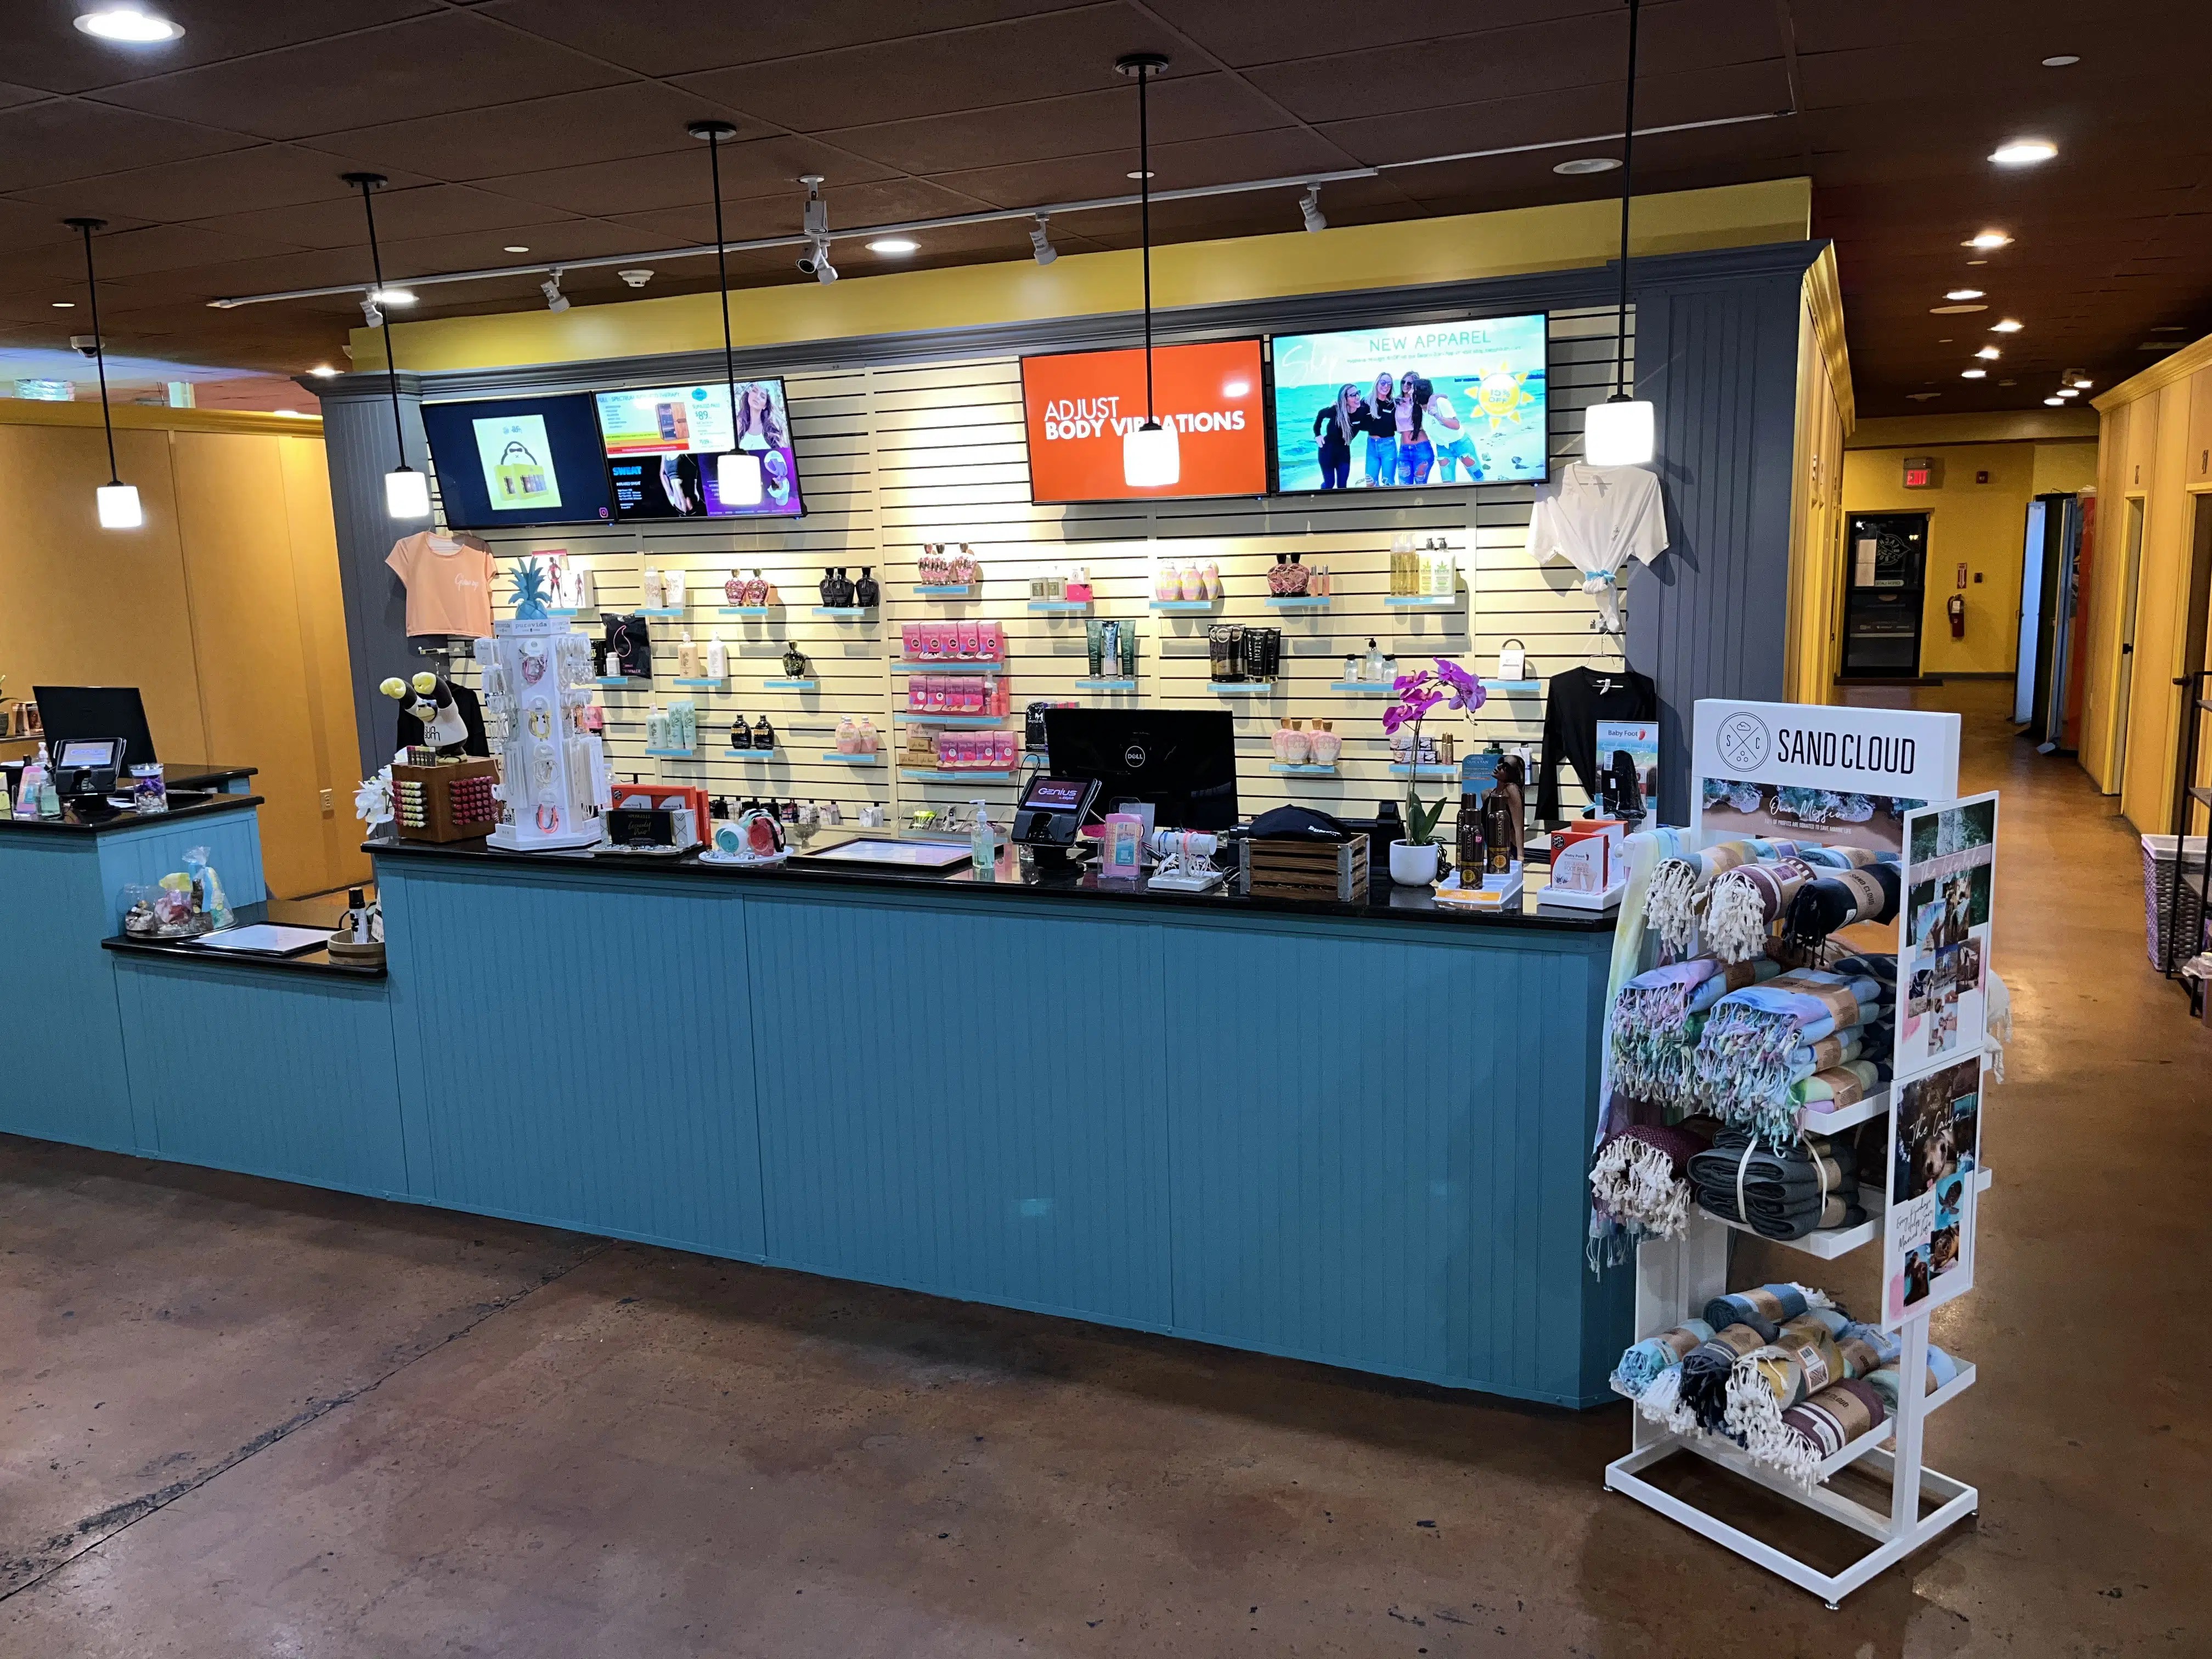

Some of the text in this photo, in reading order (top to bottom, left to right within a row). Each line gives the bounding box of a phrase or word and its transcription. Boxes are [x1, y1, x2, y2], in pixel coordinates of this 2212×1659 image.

[1369, 330, 1491, 352] NEW APPAREL
[1490, 388, 1510, 398] 15%
[1044, 396, 1120, 421] ADJUST
[1046, 419, 1105, 441] BODY
[612, 466, 642, 476] SWEAT
[1907, 470, 1927, 486] EXIT
[1726, 735, 1731, 747] S
[1756, 737, 1760, 749] C
[1778, 729, 1916, 774] SAND CLOUD
[1769, 795, 1847, 823] Our Mission
[1850, 874, 1875, 905] SAND CLOUD
[1909, 1113, 1928, 1147] The
